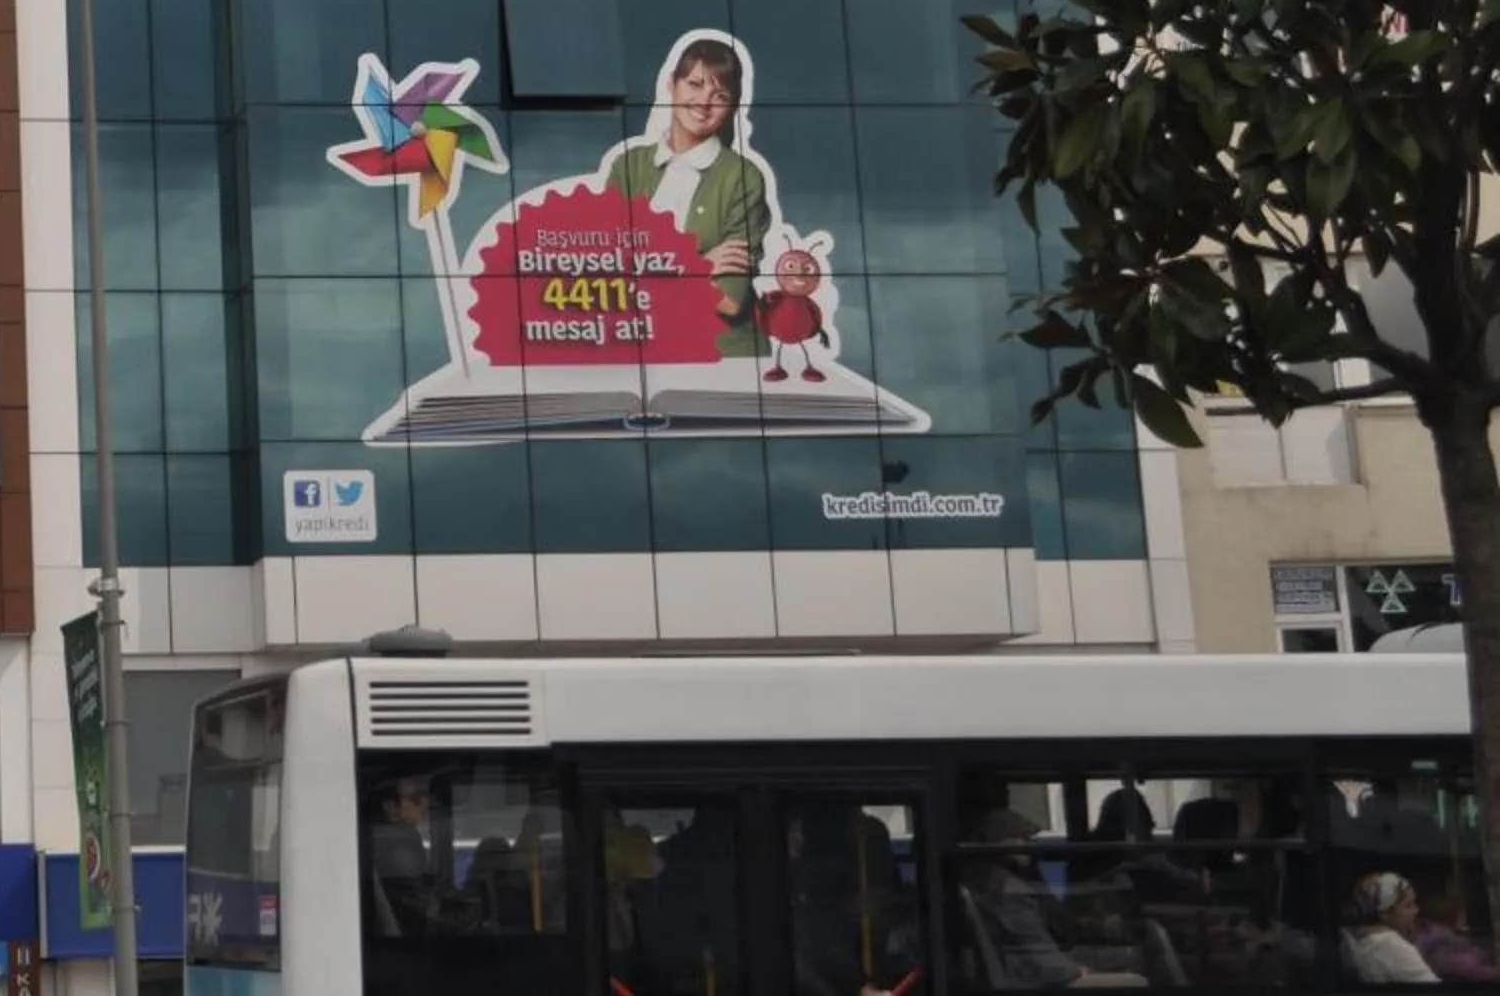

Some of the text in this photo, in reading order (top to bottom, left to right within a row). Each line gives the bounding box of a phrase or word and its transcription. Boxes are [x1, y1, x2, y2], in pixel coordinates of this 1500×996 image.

[536, 229, 610, 248] Başvuru
[518, 247, 684, 276] Bireysel yaz,
[525, 315, 655, 345] mesaj at!
